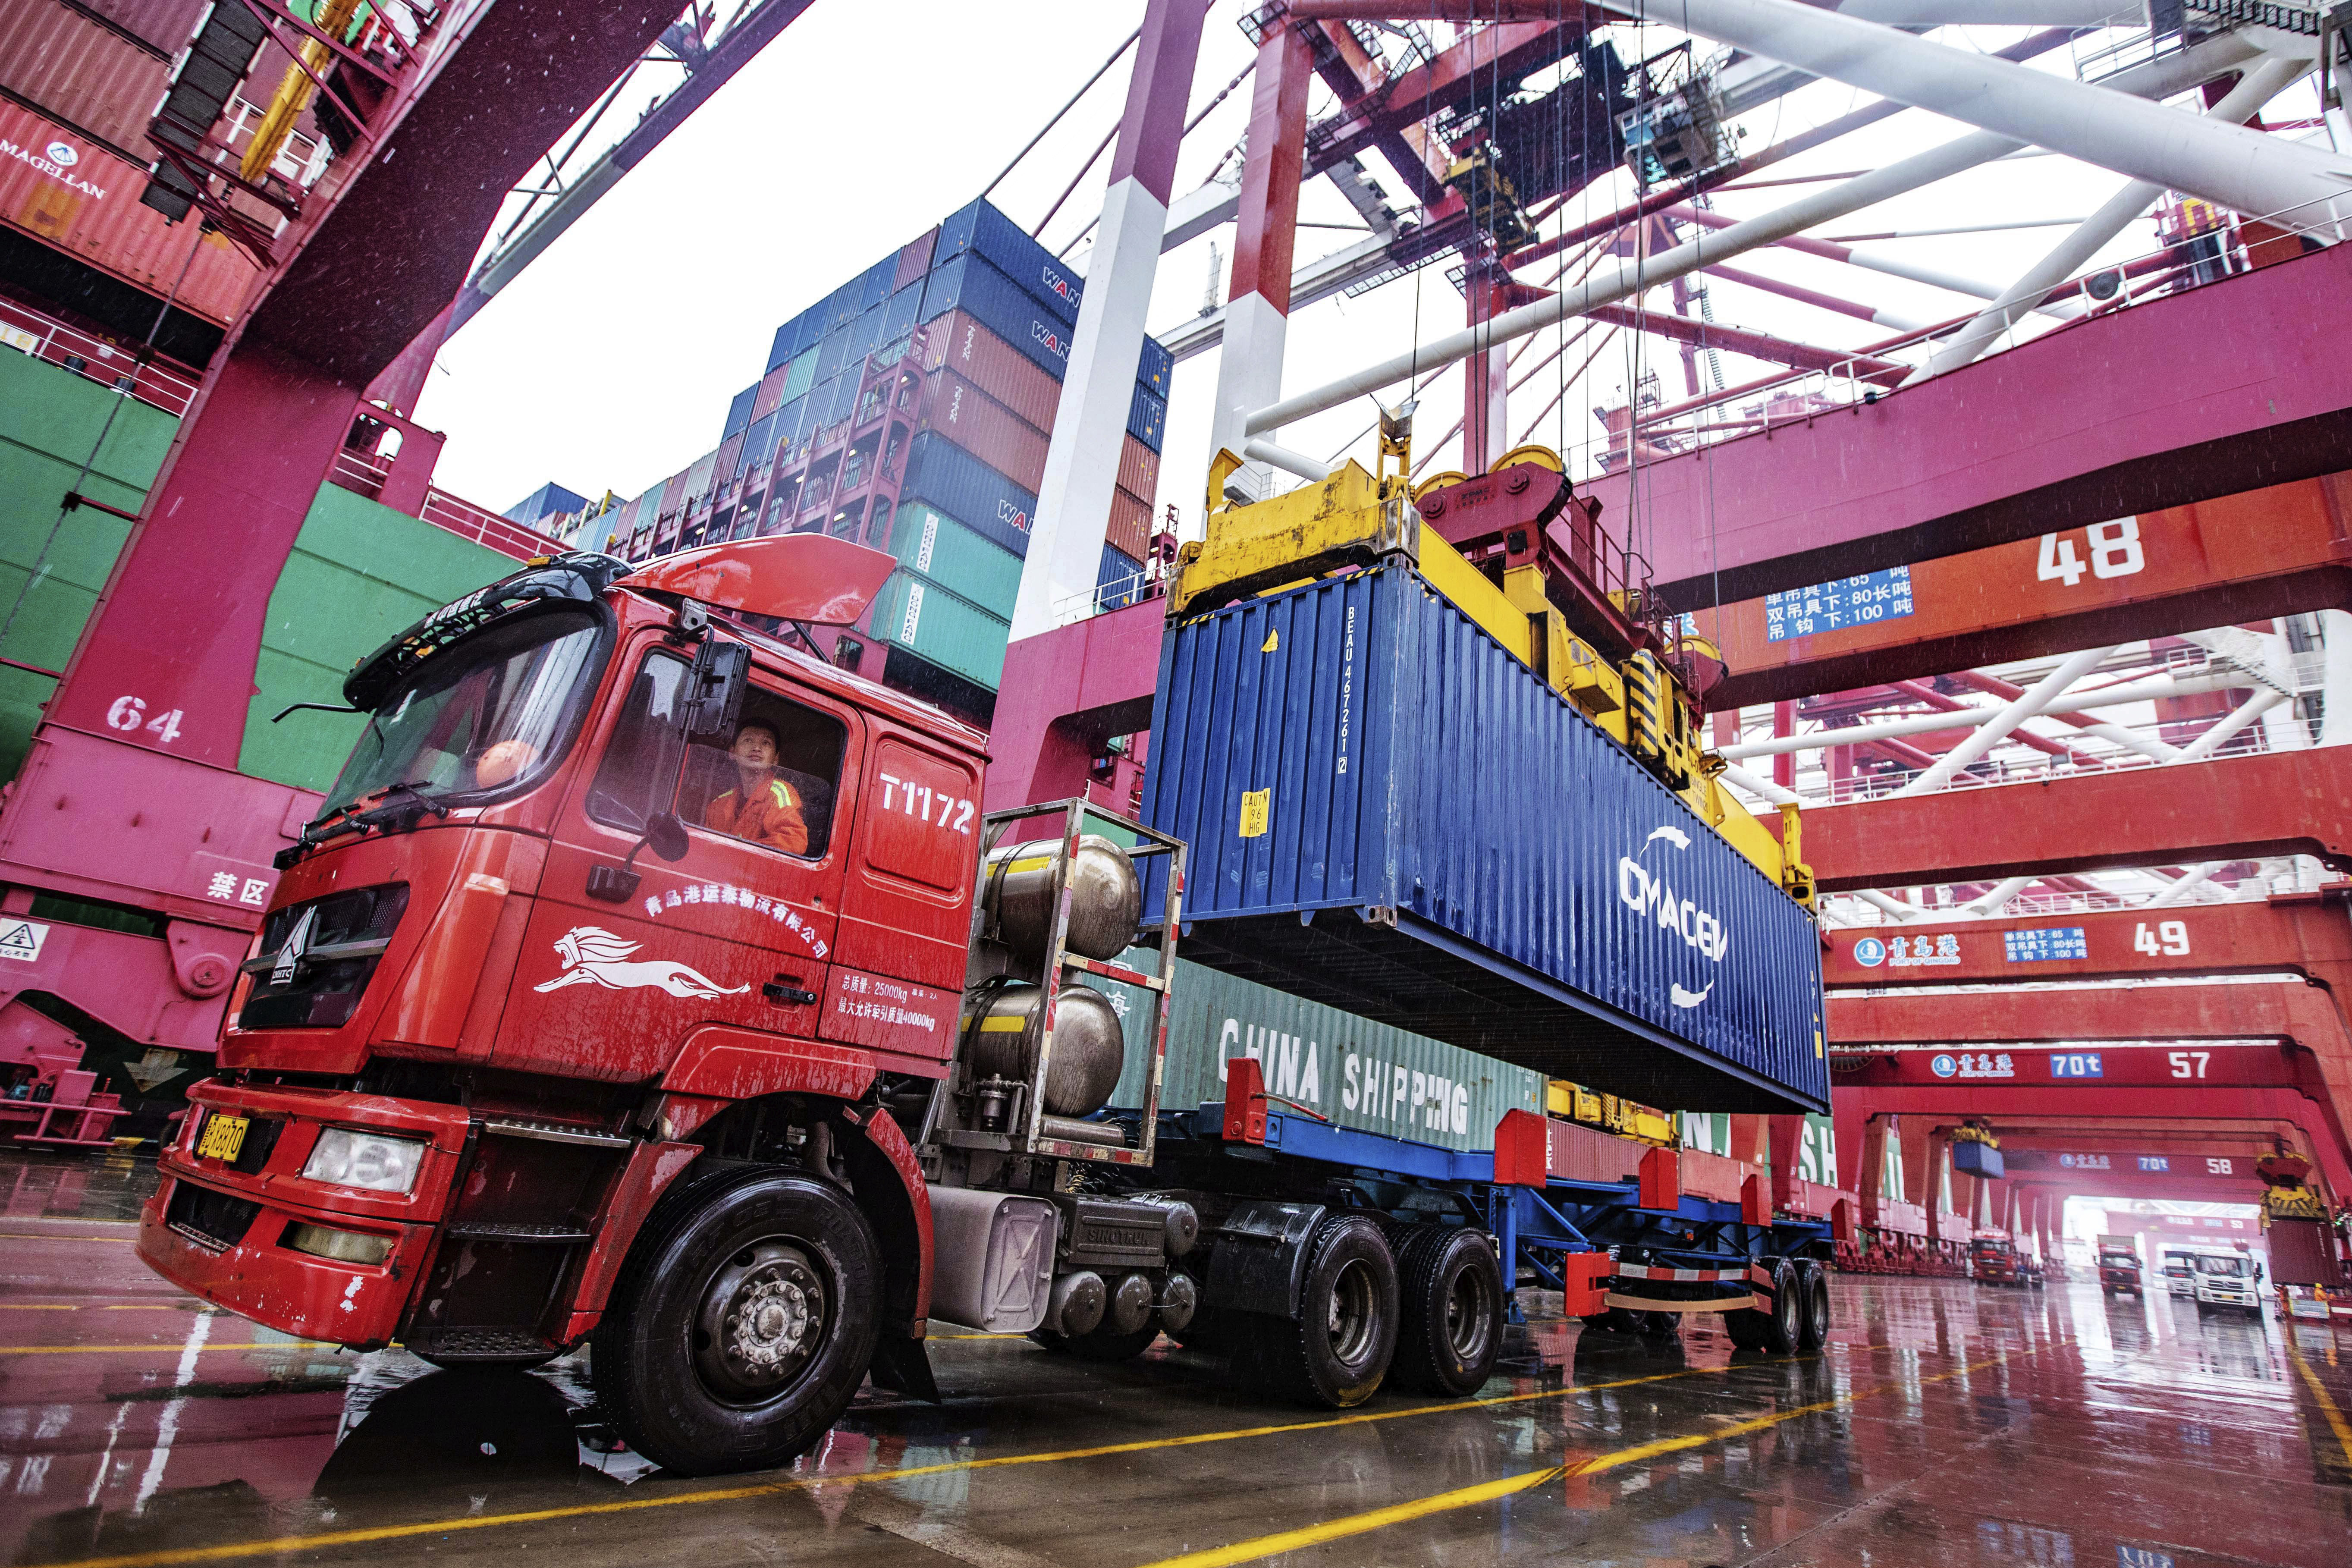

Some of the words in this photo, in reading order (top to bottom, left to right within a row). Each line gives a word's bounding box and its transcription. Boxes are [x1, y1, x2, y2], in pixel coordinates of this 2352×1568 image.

[0, 139, 107, 200] MAGELLAN
[1043, 266, 1082, 308] WAN
[1032, 321, 1071, 361] WAN
[2037, 515, 2145, 587] 48
[107, 695, 184, 742] 64
[1342, 665, 1352, 752] 467261
[1338, 757, 1347, 773] 2
[880, 773, 975, 835] T1172
[207, 871, 270, 906] 禁区
[2134, 921, 2190, 957] 49
[1890, 958, 1911, 966] PORT
[1912, 957, 1923, 965] OF
[1923, 956, 1961, 966] QINGDAO
[1218, 1018, 1319, 1103] CHINA
[1342, 1053, 1468, 1135] SHIPPING
[2053, 1056, 2101, 1076] 70t
[2168, 1051, 2211, 1078] 57
[2139, 1157, 2168, 1170] 70t
[2206, 1158, 2233, 1175] 58
